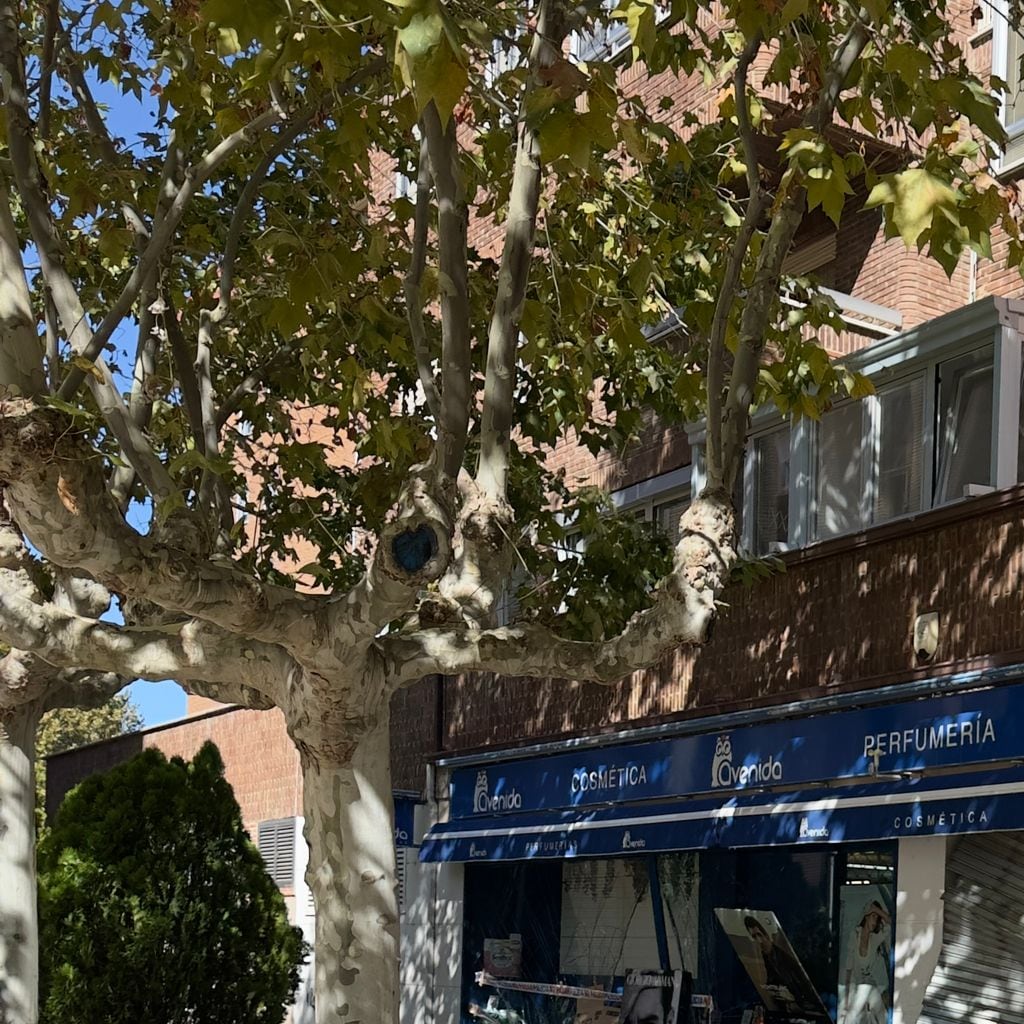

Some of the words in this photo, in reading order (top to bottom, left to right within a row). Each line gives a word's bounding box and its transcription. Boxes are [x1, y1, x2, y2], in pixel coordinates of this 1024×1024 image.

[863, 711, 996, 758] PERFUMERÍA
[571, 764, 648, 793] COSMÉTICA
[893, 810, 988, 829] COSMÉTICA
